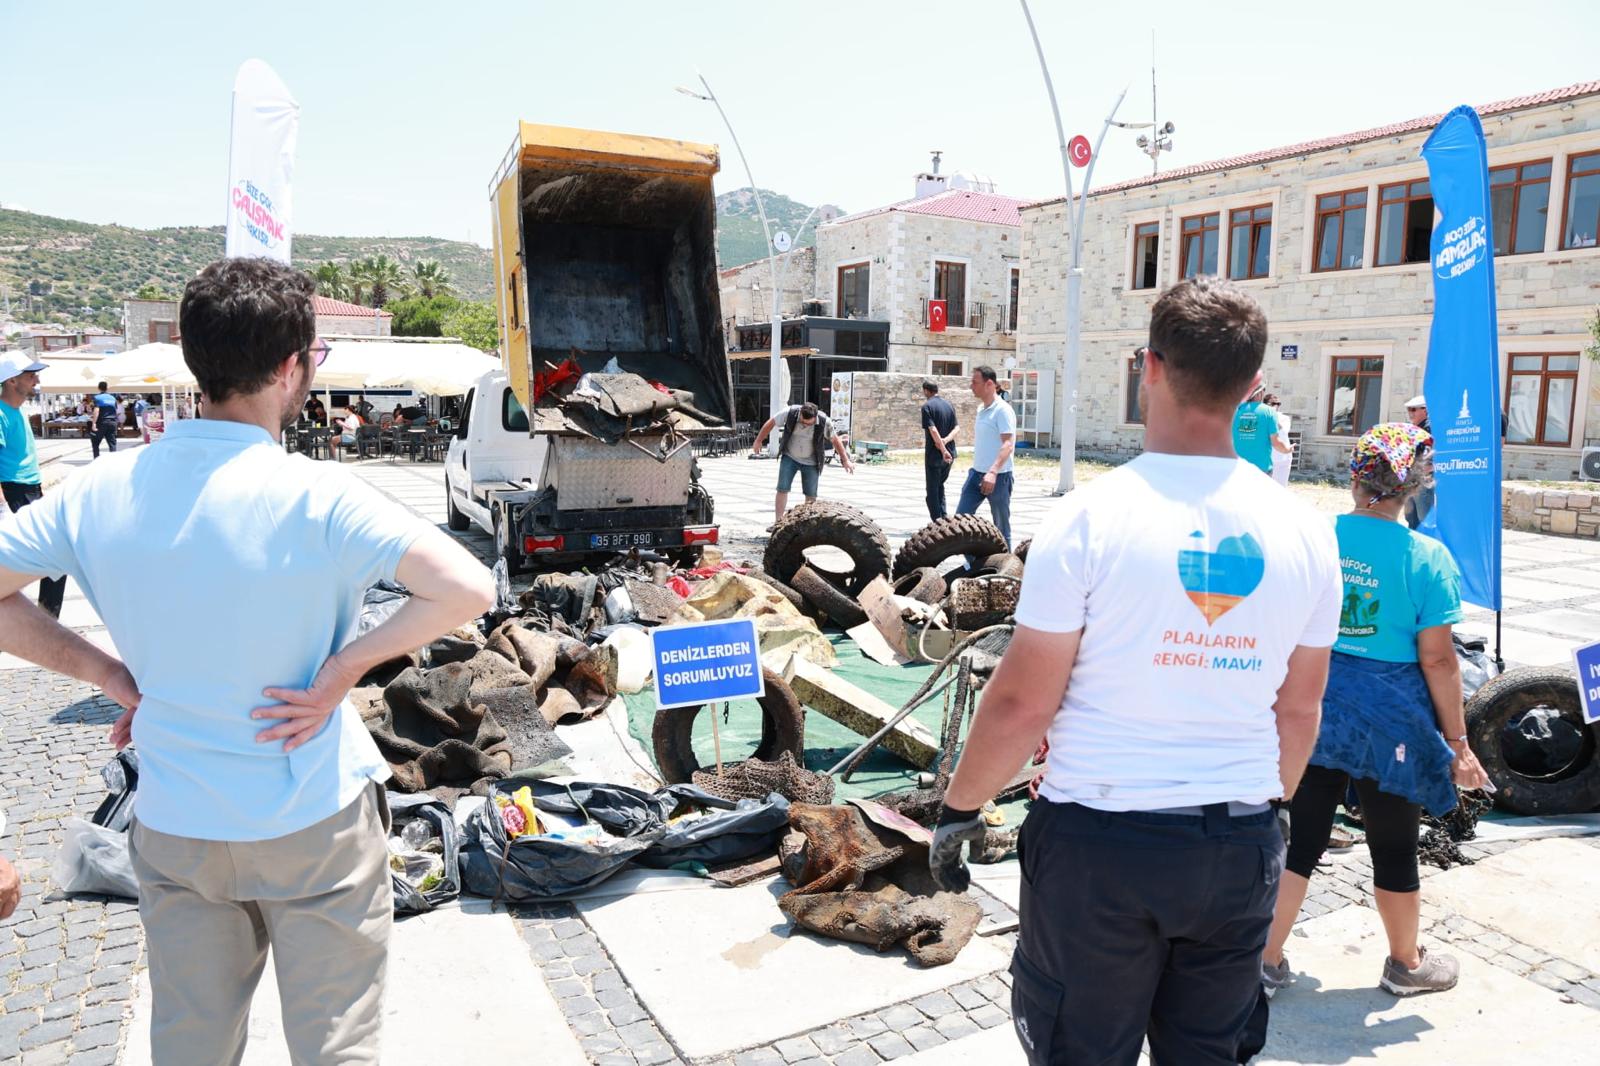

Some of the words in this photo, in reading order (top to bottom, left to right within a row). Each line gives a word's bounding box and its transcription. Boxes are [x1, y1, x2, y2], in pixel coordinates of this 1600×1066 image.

[597, 535, 609, 546] 35
[633, 533, 651, 545] 990
[1340, 555, 1373, 576] NİFOÇA
[1162, 630, 1256, 649] PLAJLARIN
[661, 641, 750, 665] DENİZLERDEN
[1153, 652, 1209, 669] RENGİ:
[1212, 655, 1262, 672] MAVİ!
[663, 663, 753, 687] SORUMLUYUZ
